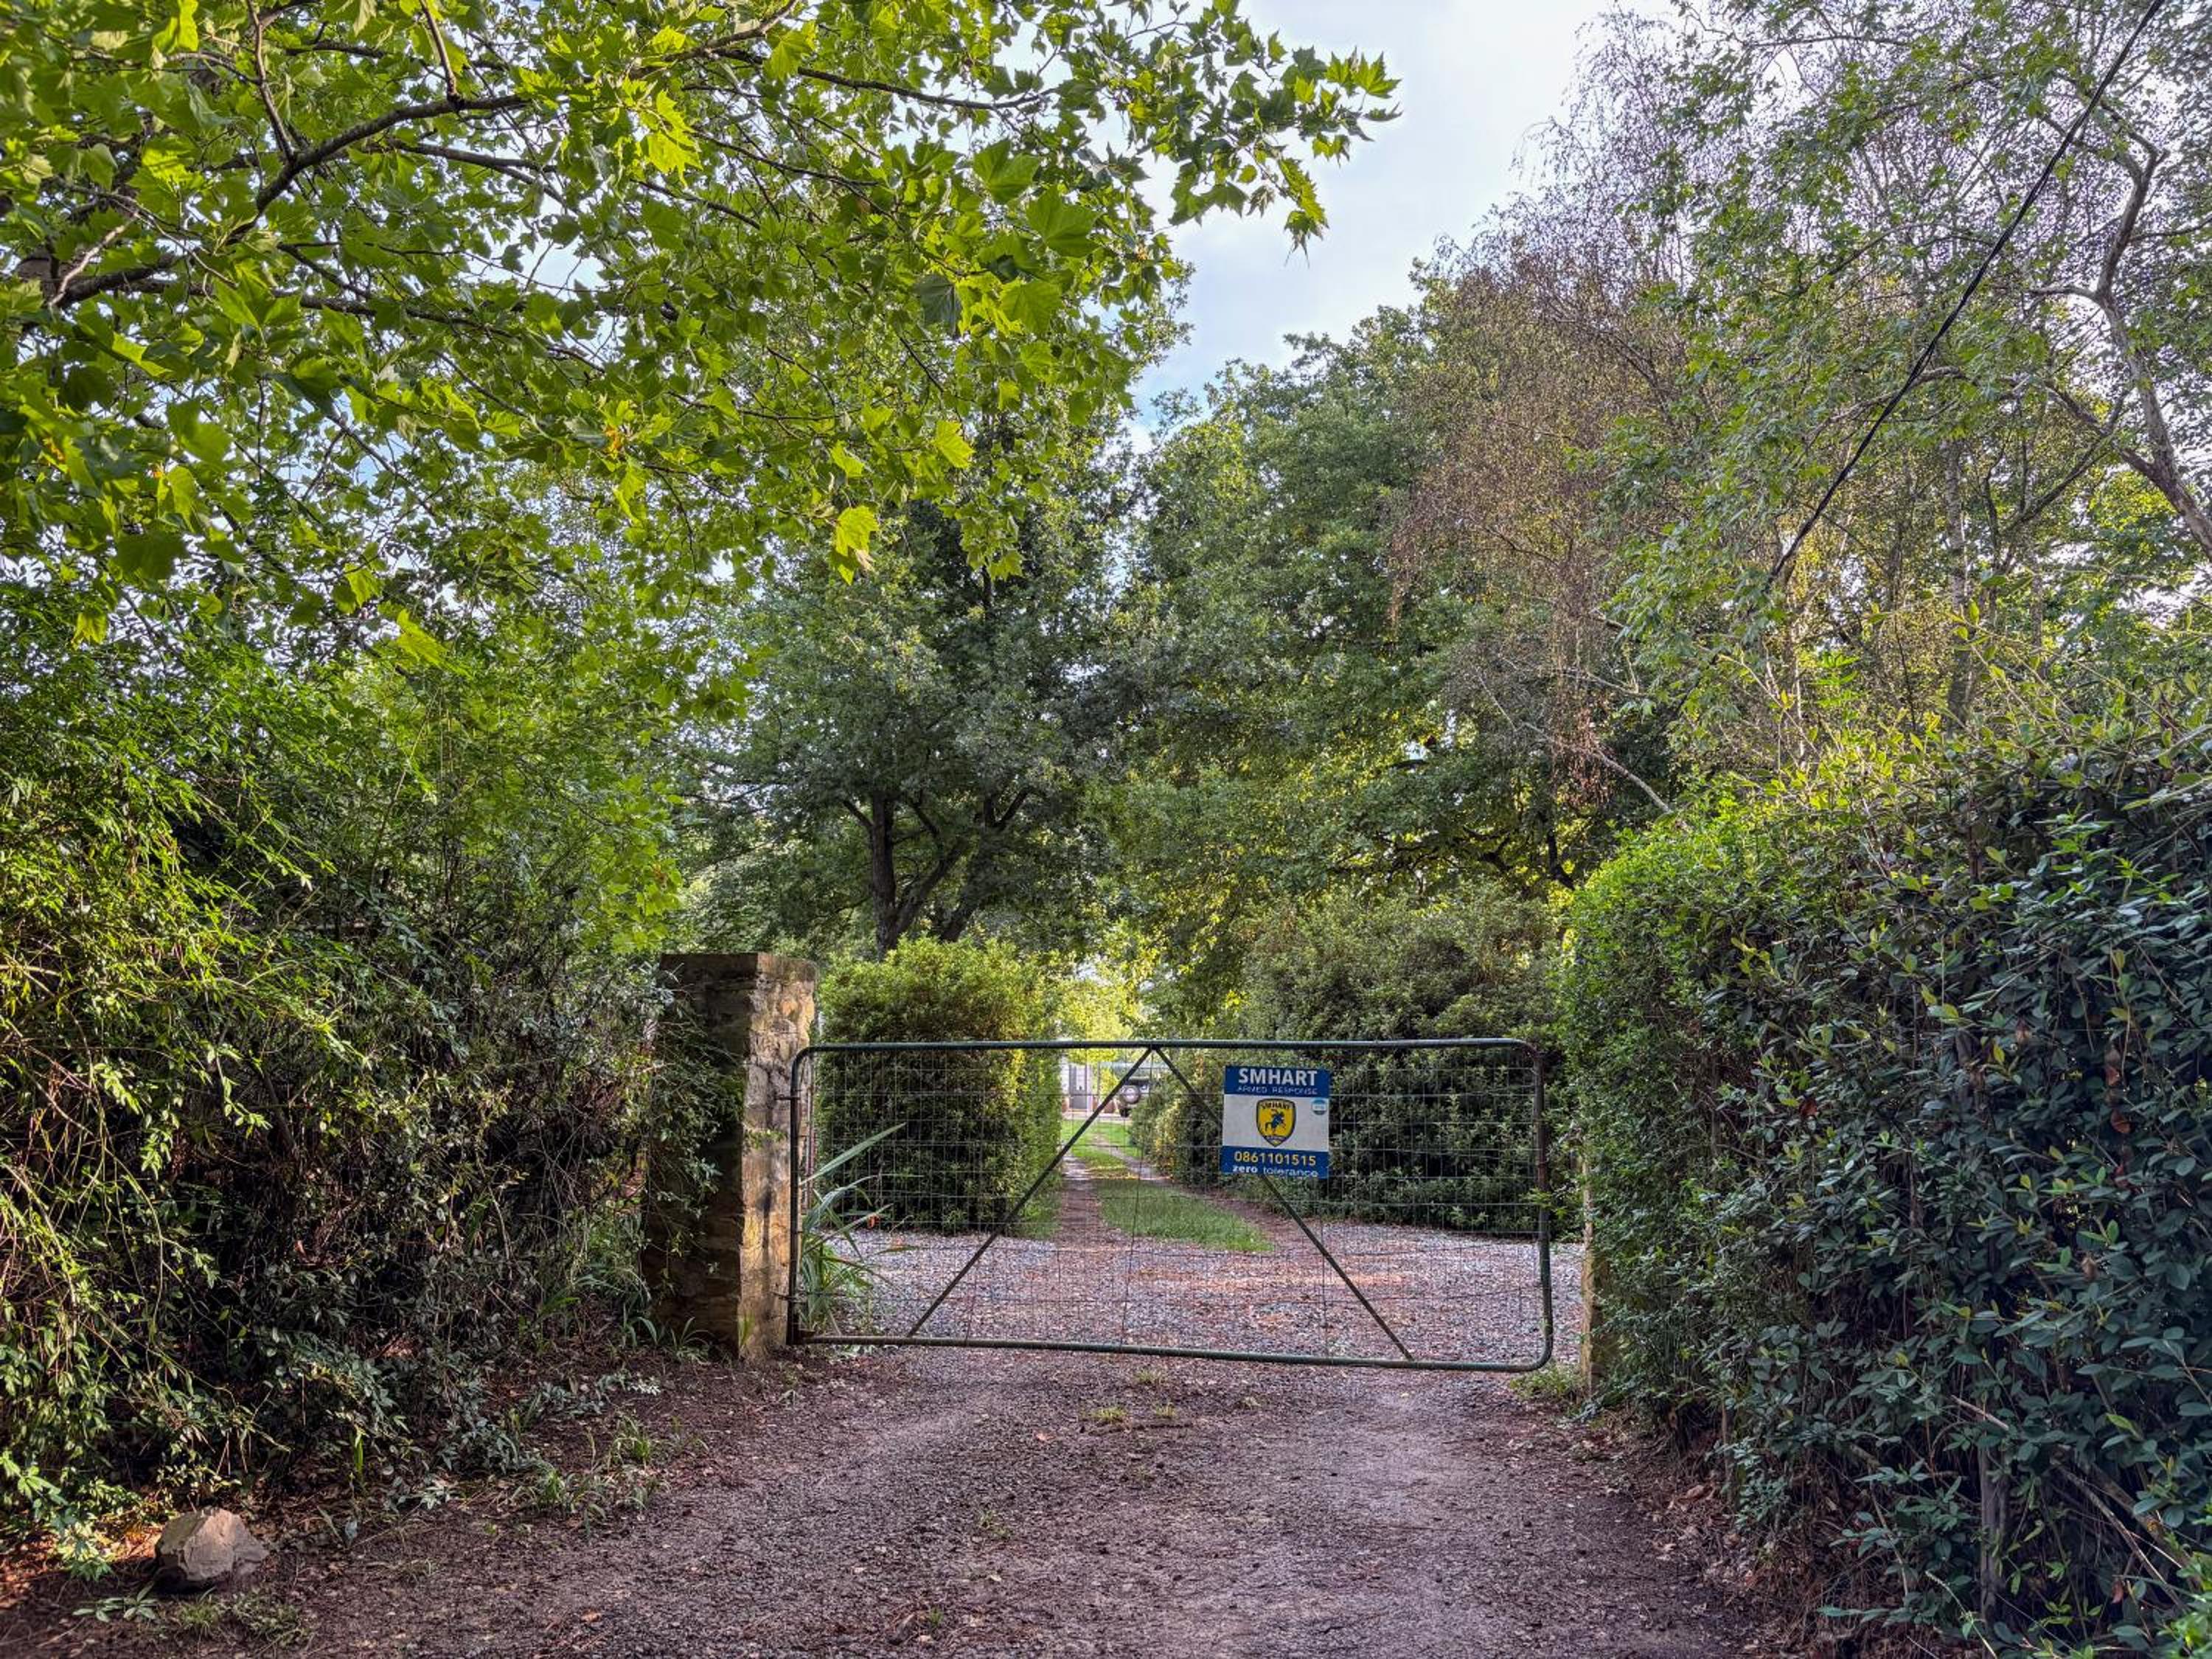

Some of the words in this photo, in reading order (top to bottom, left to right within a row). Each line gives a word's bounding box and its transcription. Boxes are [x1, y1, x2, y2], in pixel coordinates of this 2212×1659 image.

[1238, 1068, 1318, 1086] SMHART
[1234, 1151, 1316, 1166] 0861101515
[1232, 1165, 1258, 1173] zero
[1263, 1166, 1318, 1178] tolerance
